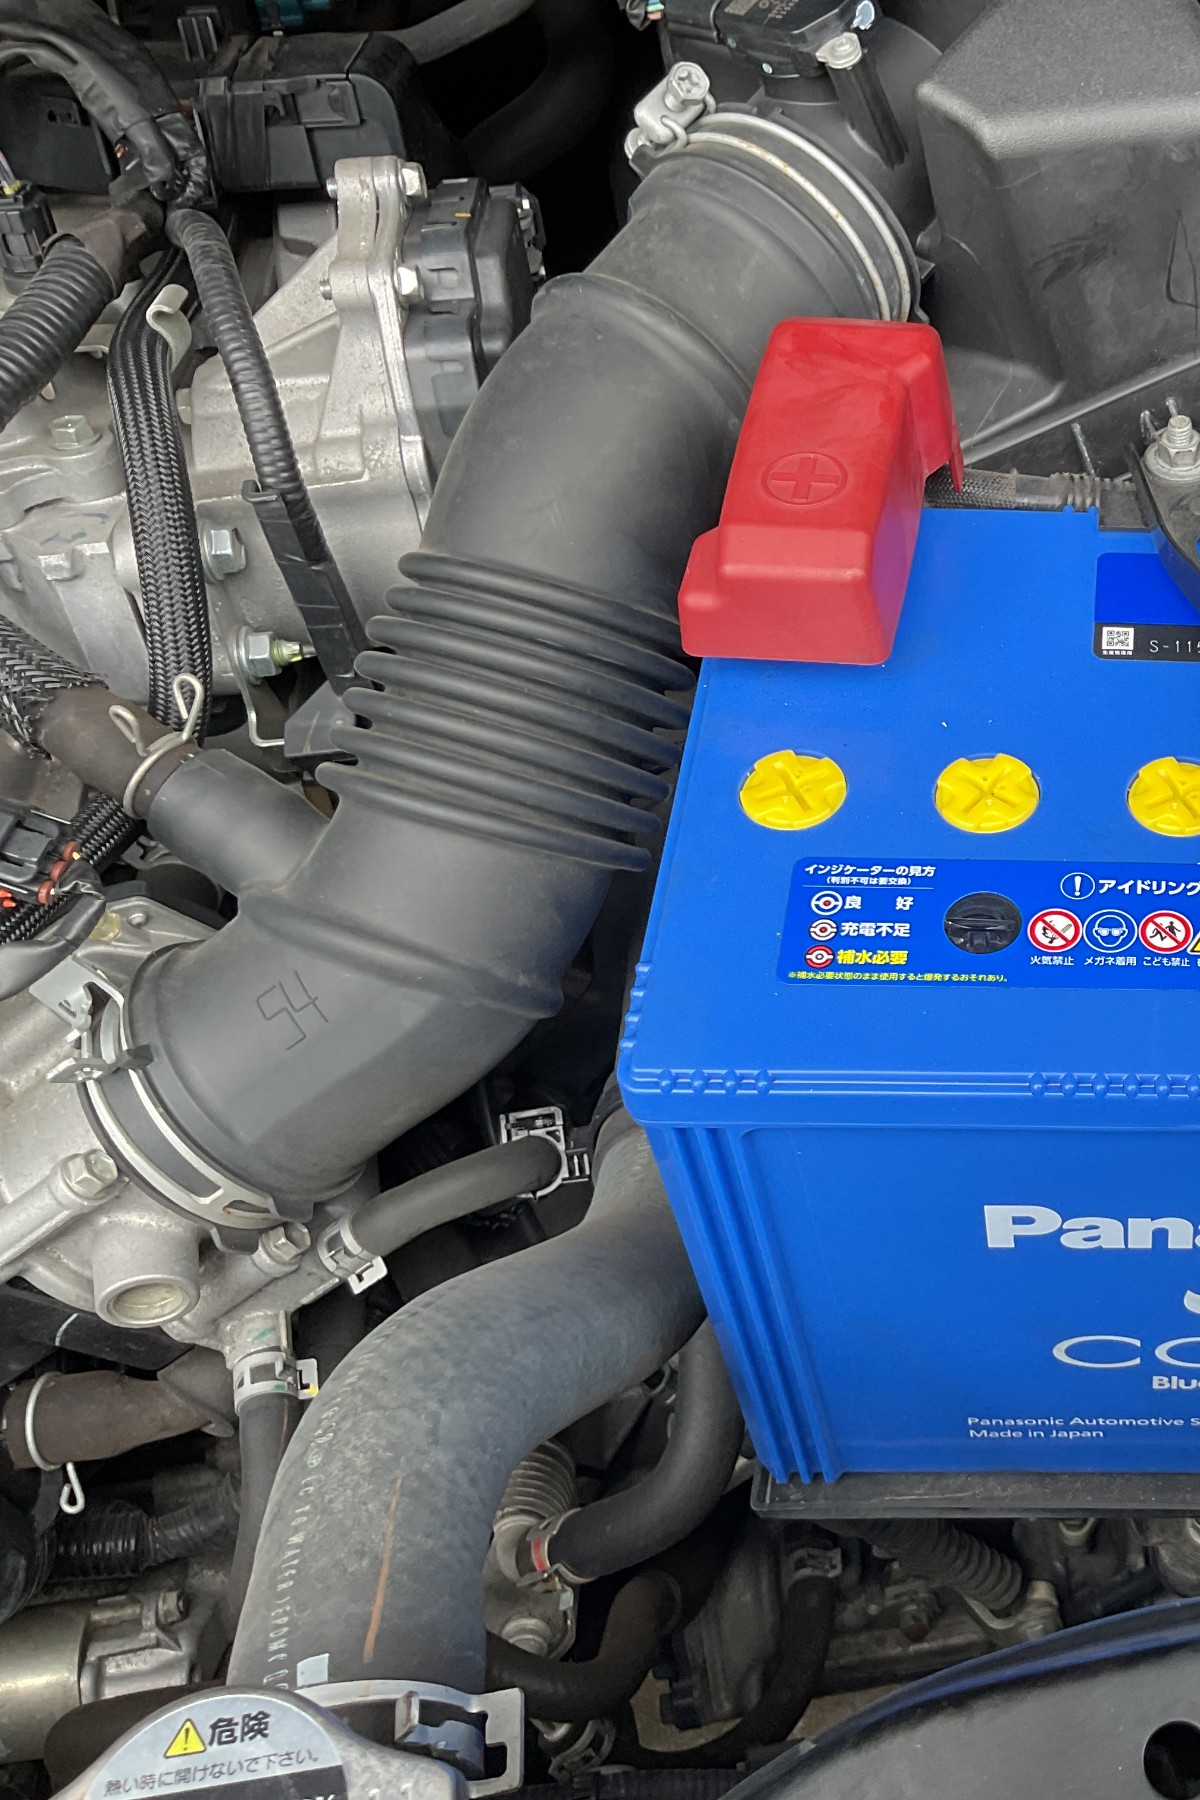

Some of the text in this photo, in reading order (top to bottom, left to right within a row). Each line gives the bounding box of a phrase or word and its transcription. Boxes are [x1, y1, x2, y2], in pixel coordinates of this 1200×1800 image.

[804, 863, 936, 877] インジケーターの見方
[844, 896, 914, 911] 良 好
[841, 922, 911, 938] 充電不足
[837, 950, 909, 965] 補水必要
[1030, 955, 1075, 966] 火気禁止
[1084, 956, 1137, 966] メガネ着用
[1143, 957, 1190, 967] こども禁止
[967, 1416, 1065, 1427] Panasonic
[1069, 1416, 1185, 1427] Automotive
[969, 1429, 1104, 1440] Made in Japan
[208, 1710, 271, 1747] 危険
[104, 1750, 320, 1796] 熱い時に開けないで下さい。
